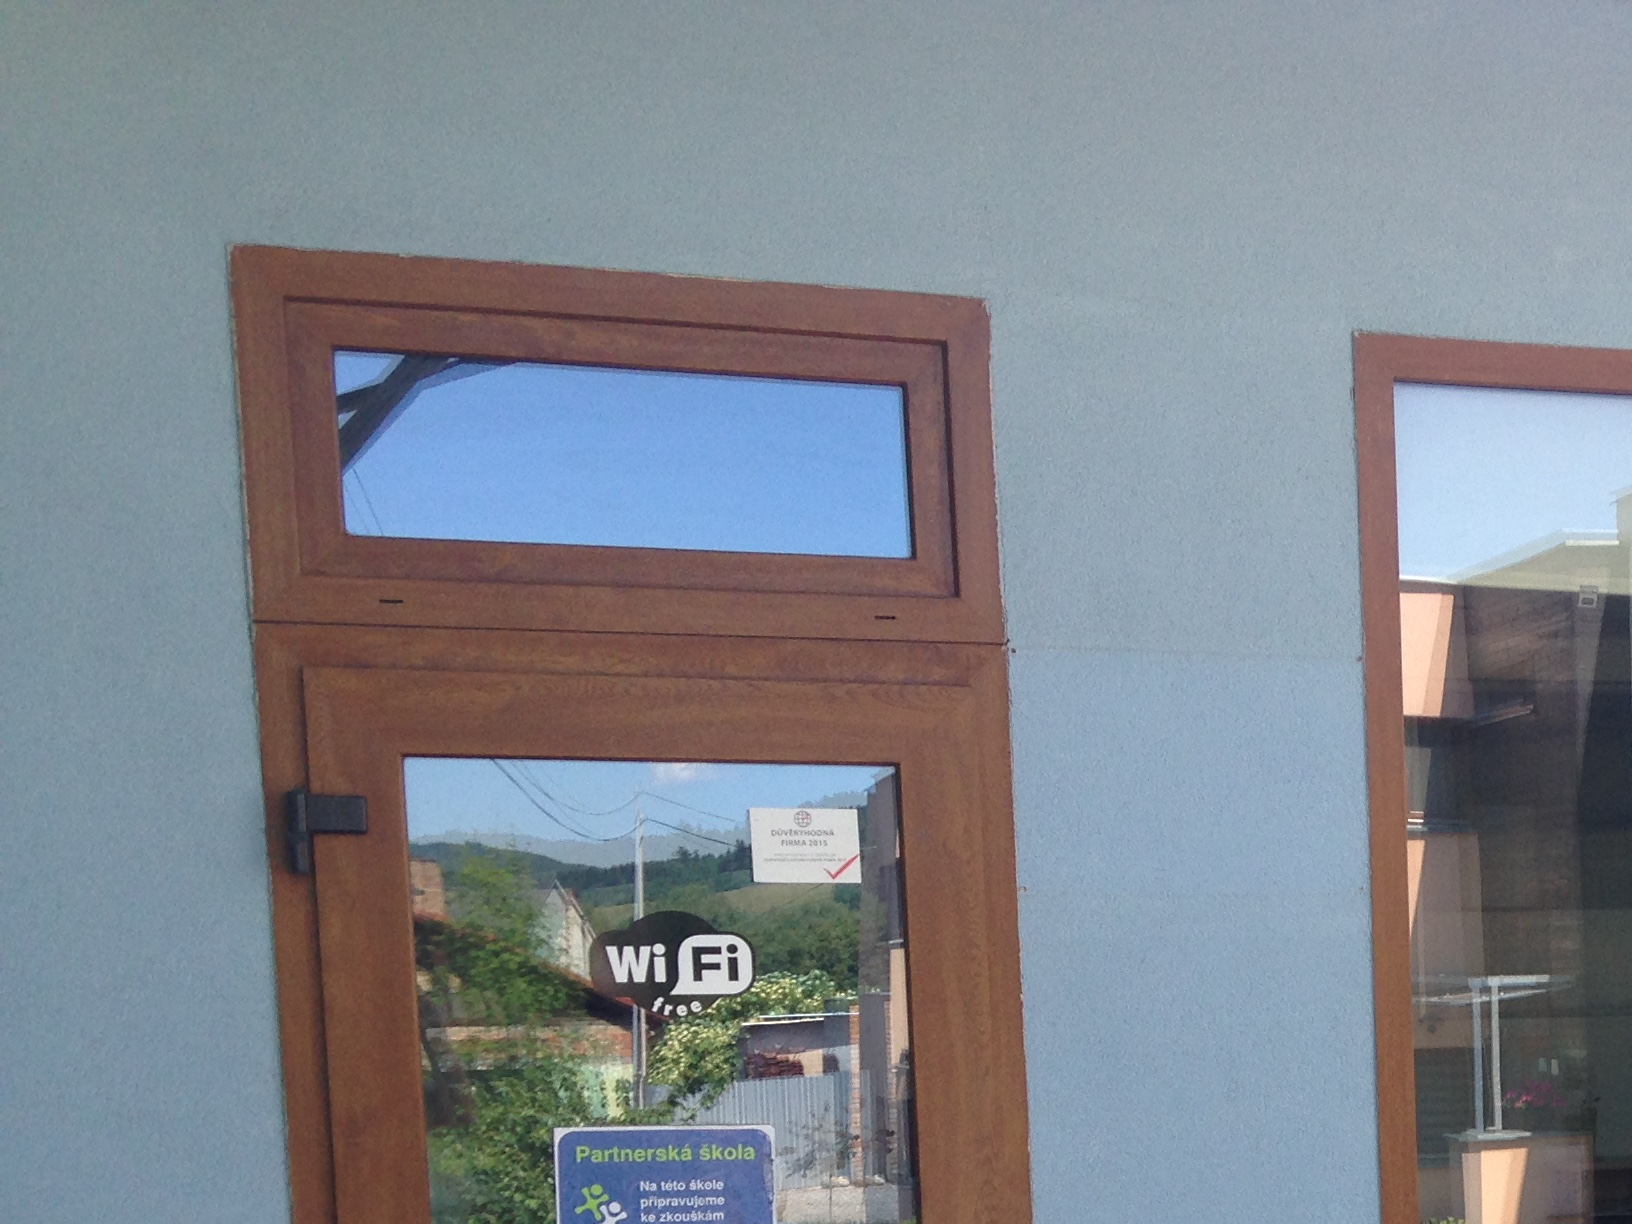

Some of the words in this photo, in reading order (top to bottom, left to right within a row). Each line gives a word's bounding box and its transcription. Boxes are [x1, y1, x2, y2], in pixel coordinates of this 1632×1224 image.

[781, 839, 807, 847] FIRMA
[809, 839, 828, 847] 2015
[651, 997, 702, 1017] free
[575, 1144, 692, 1163] Partnerská
[699, 1144, 757, 1161] škola
[640, 1181, 657, 1191] Na
[661, 1180, 686, 1191] této
[689, 1179, 724, 1190] škole
[640, 1213, 655, 1223] ke
[659, 1211, 725, 1222] zkouškám
